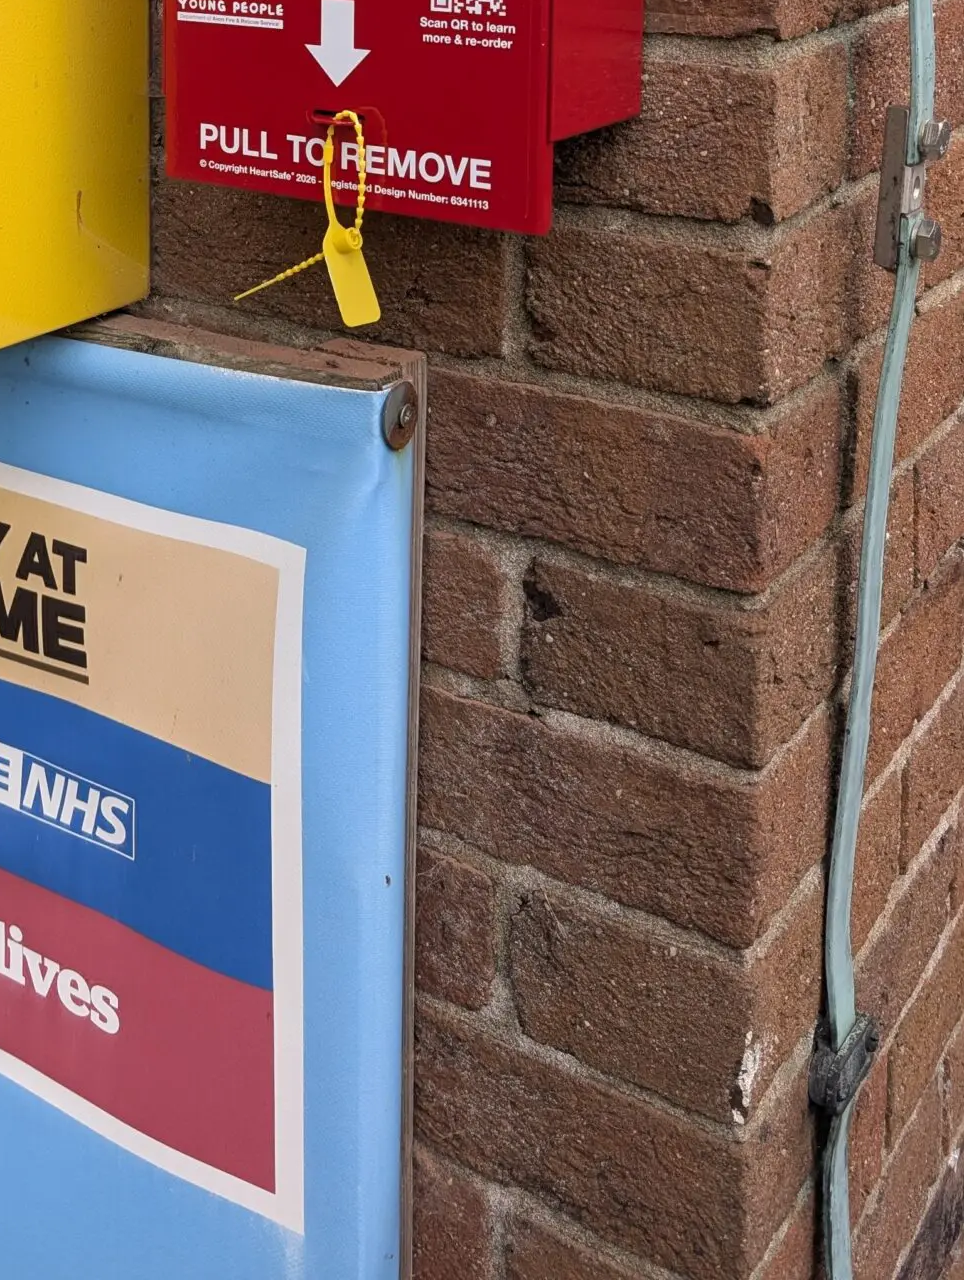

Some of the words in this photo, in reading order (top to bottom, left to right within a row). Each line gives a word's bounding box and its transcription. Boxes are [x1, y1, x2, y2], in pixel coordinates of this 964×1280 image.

[233, 1, 284, 16] PEOPLE
[420, 16, 447, 29] Scan
[451, 19, 469, 30] QR
[471, 21, 483, 31] to
[487, 22, 516, 34] learn
[423, 34, 451, 44] more
[454, 34, 463, 45] &
[465, 36, 513, 49] re-order
[200, 123, 278, 160] PULL
[286, 134, 325, 167] TO
[341, 142, 492, 190] REMOVE
[208, 161, 248, 175] Copyright
[374, 186, 406, 198] Design
[408, 190, 449, 203] Number:
[450, 196, 489, 210] 6341113
[15, 531, 87, 596] AT
[22, 762, 130, 845] NHS
